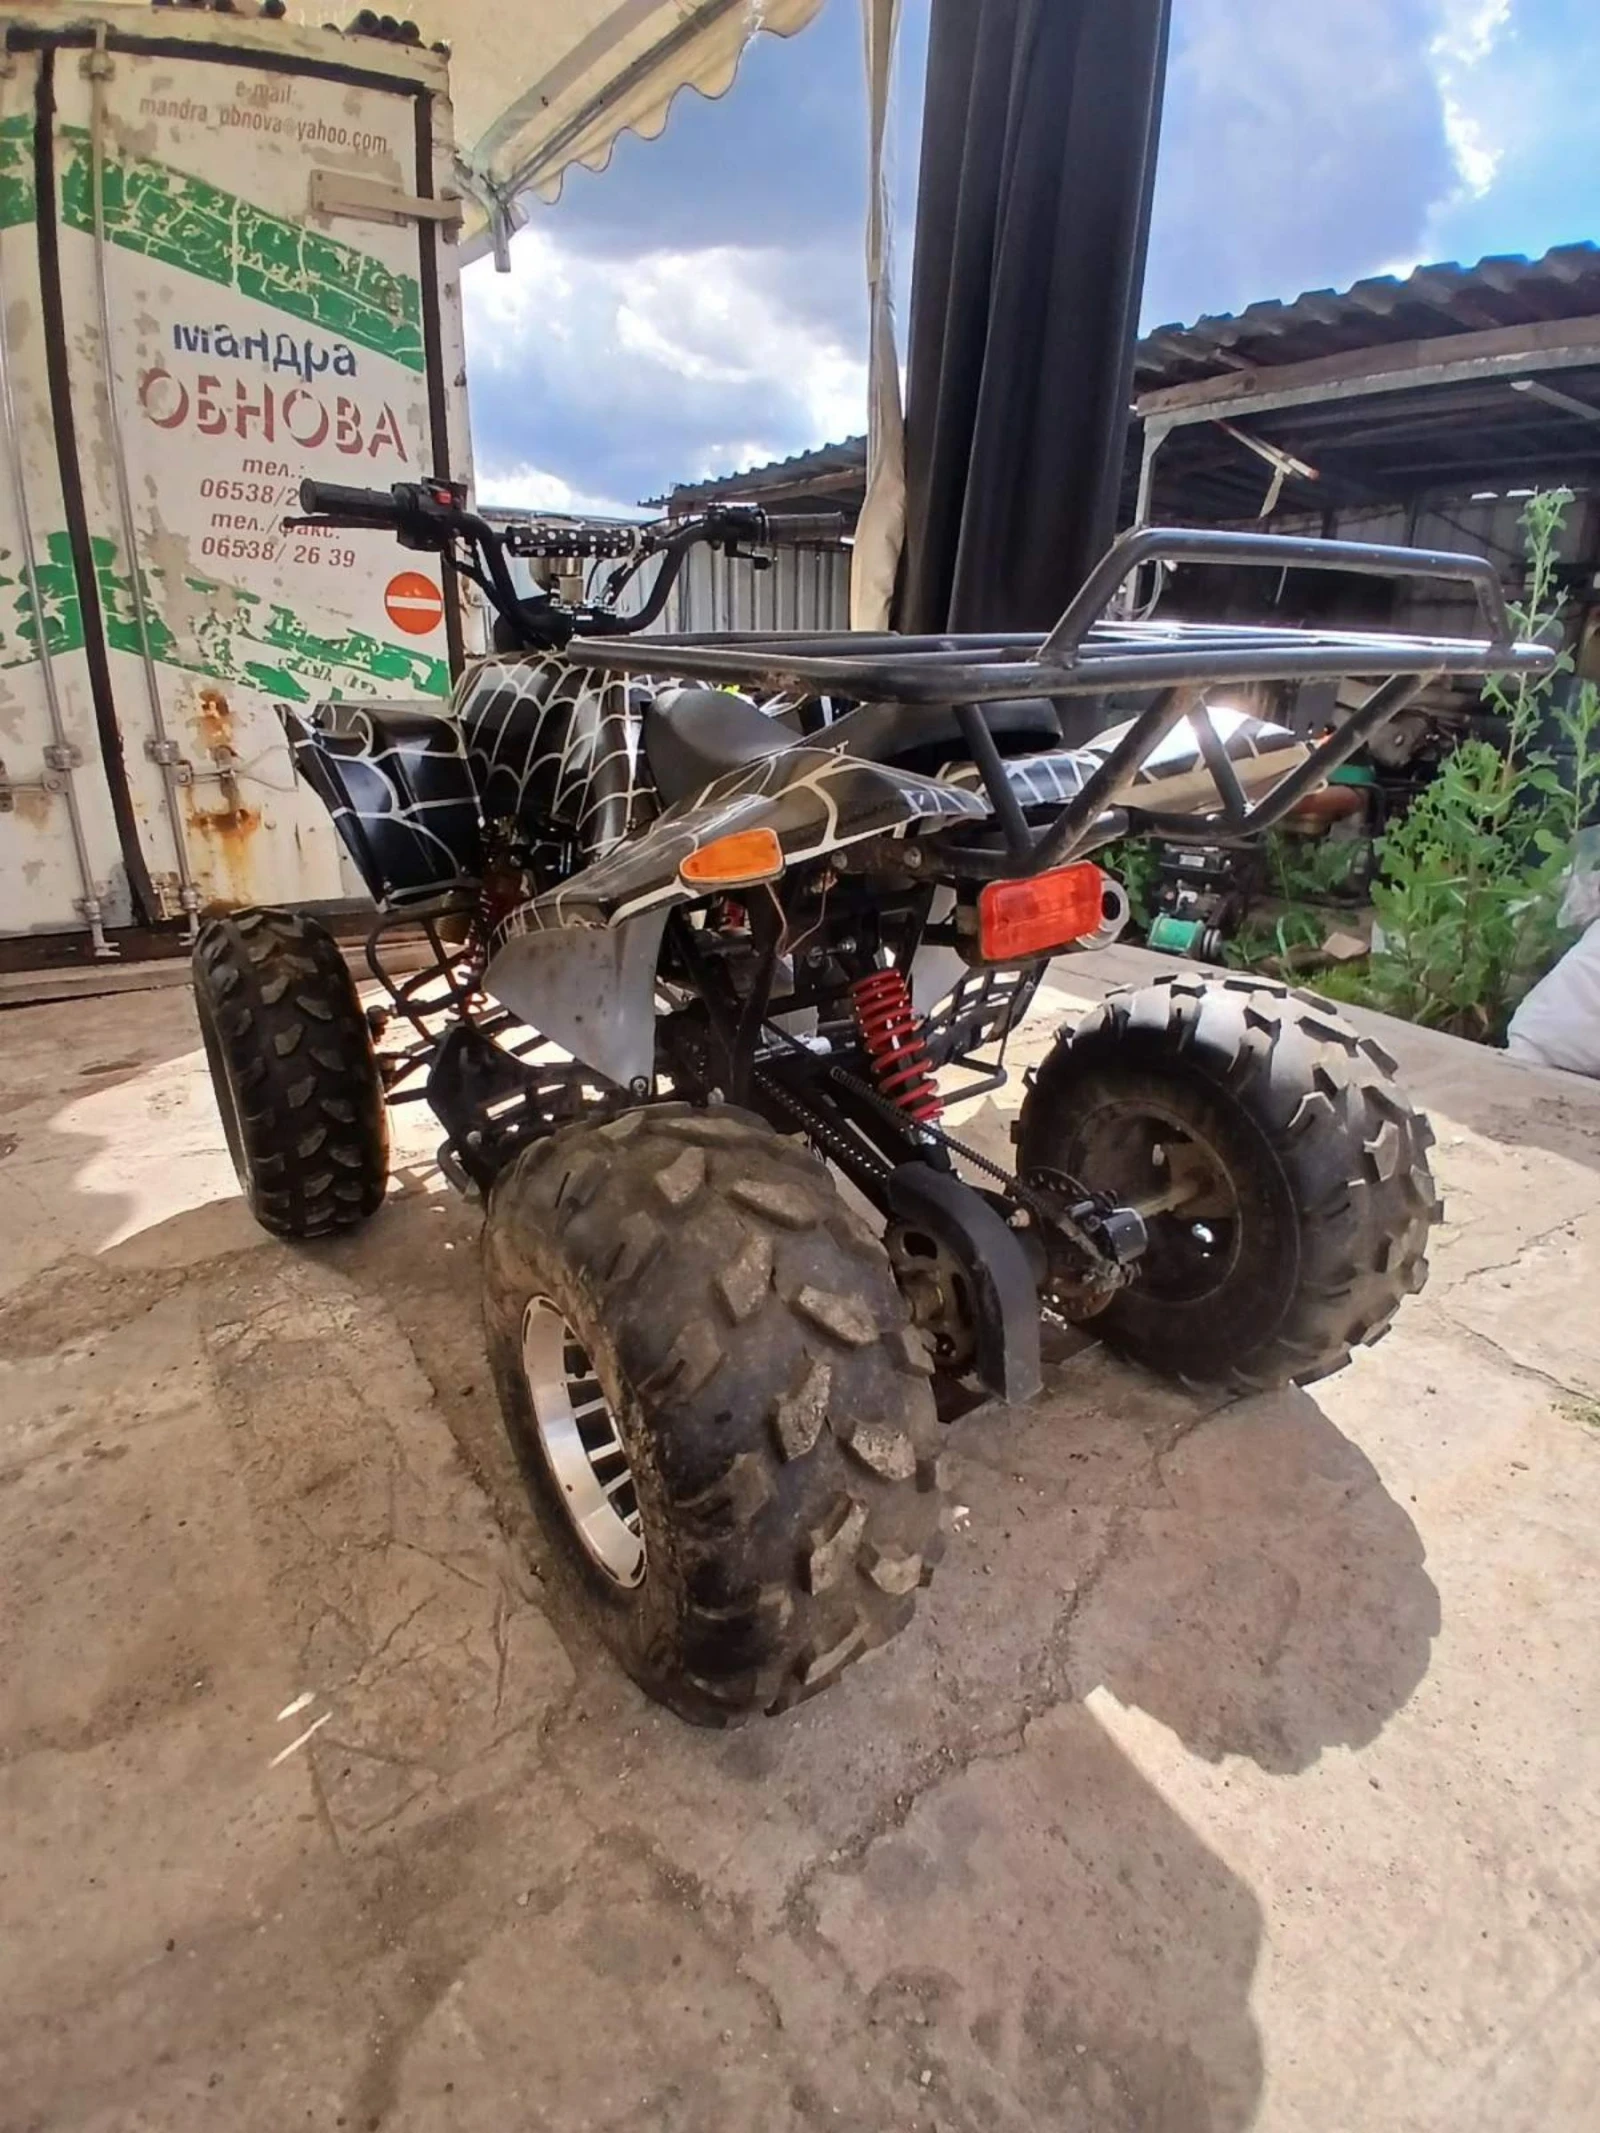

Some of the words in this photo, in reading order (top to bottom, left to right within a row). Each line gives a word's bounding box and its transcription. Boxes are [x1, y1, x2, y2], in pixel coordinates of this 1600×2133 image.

[138, 366, 408, 463] ОБНОВА
[242, 458, 304, 479] тел.:
[200, 478, 300, 507] 06538/2
[293, 544, 321, 565] 26
[328, 548, 356, 568] 39
